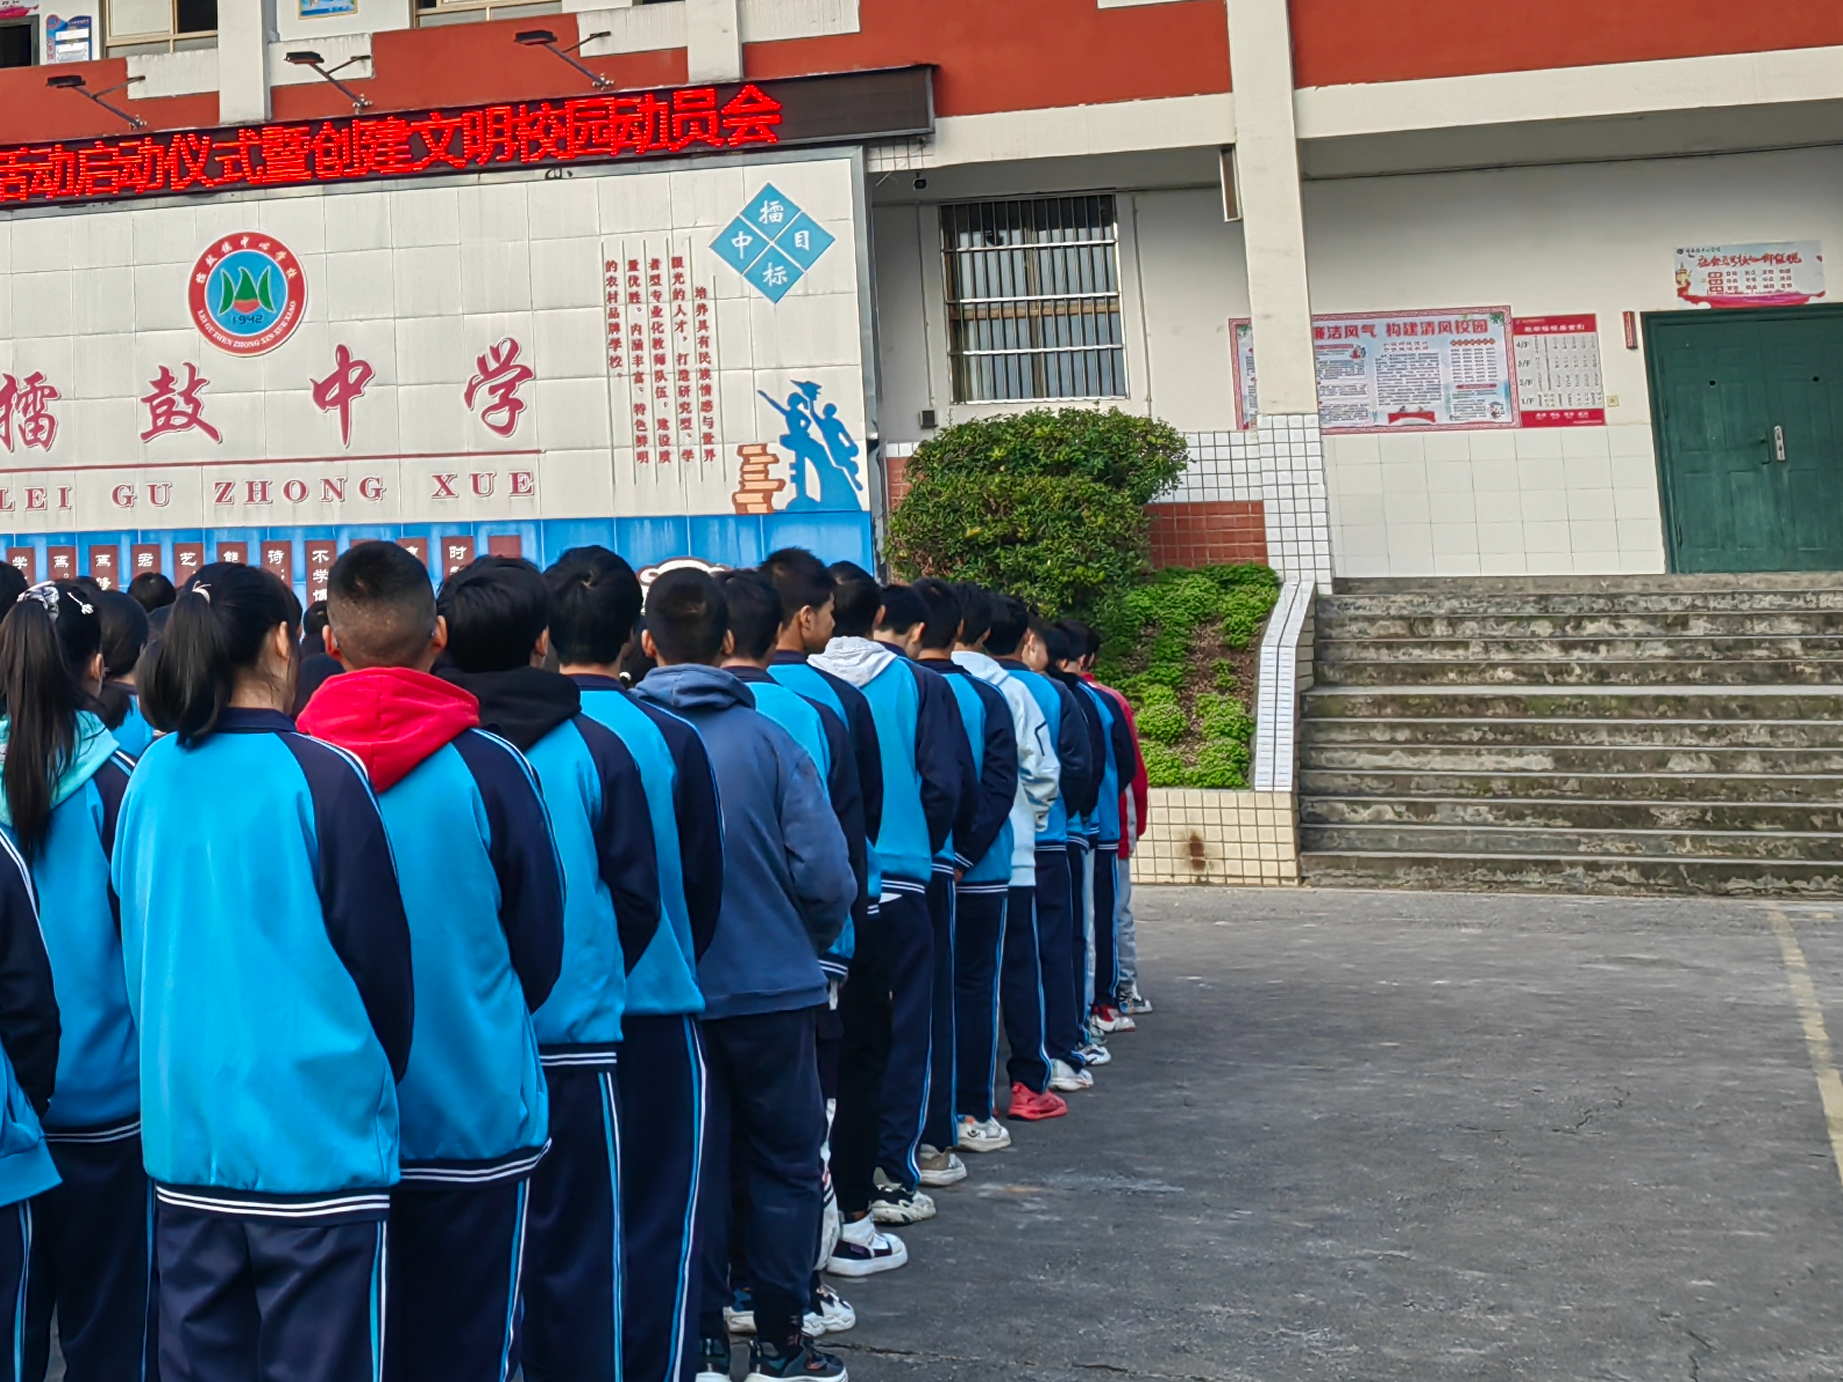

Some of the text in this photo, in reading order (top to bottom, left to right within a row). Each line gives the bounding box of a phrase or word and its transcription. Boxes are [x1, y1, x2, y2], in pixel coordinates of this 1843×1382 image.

[1386, 319, 1489, 337] 构建清风校园
[112, 482, 172, 508] GU
[214, 476, 386, 505] ZHONG
[432, 471, 535, 499] XUE
